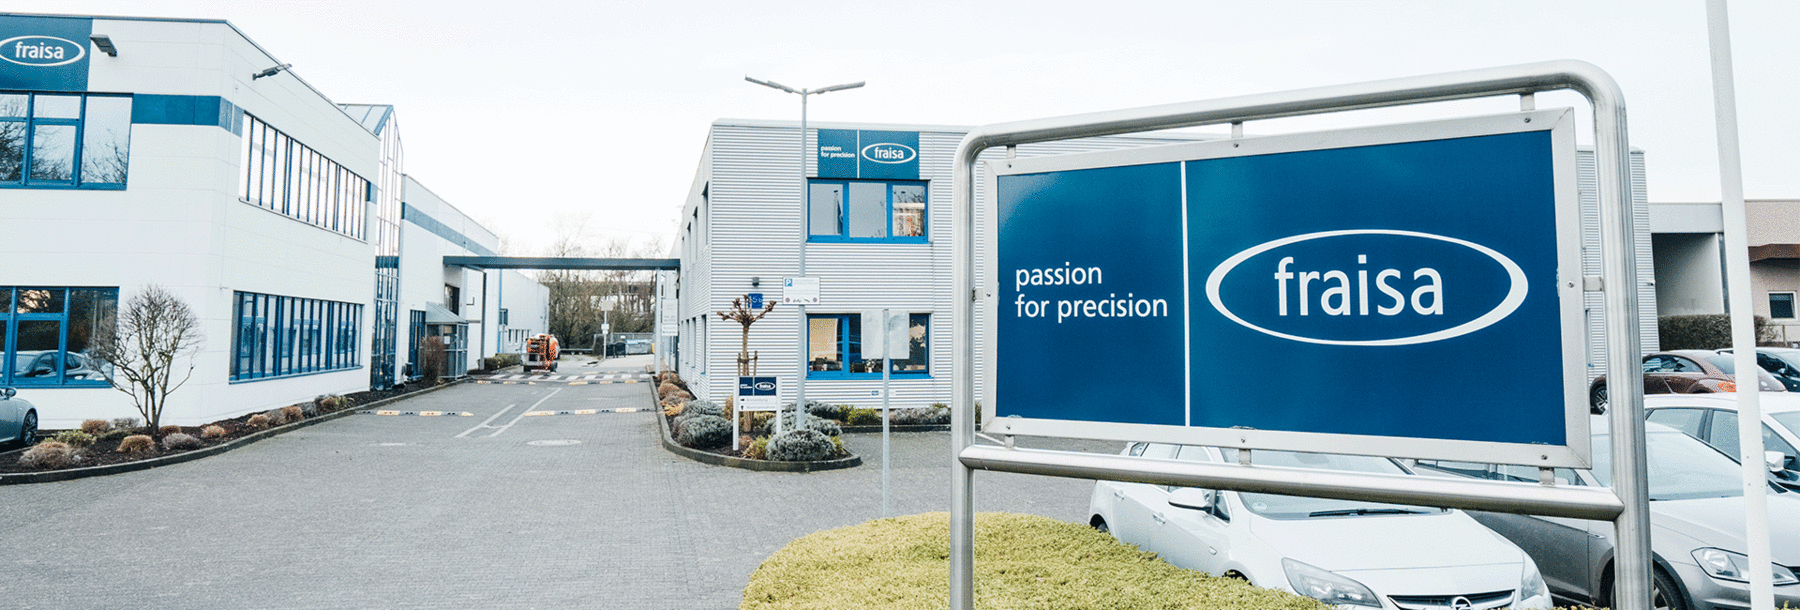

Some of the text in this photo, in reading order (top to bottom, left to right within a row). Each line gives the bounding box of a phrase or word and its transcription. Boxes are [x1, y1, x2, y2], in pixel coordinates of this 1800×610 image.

[15, 41, 64, 59] fraisa
[874, 147, 904, 159] fraisa
[1016, 261, 1102, 292] passion
[1274, 254, 1444, 316] fraisa
[1015, 293, 1168, 323] for precision
